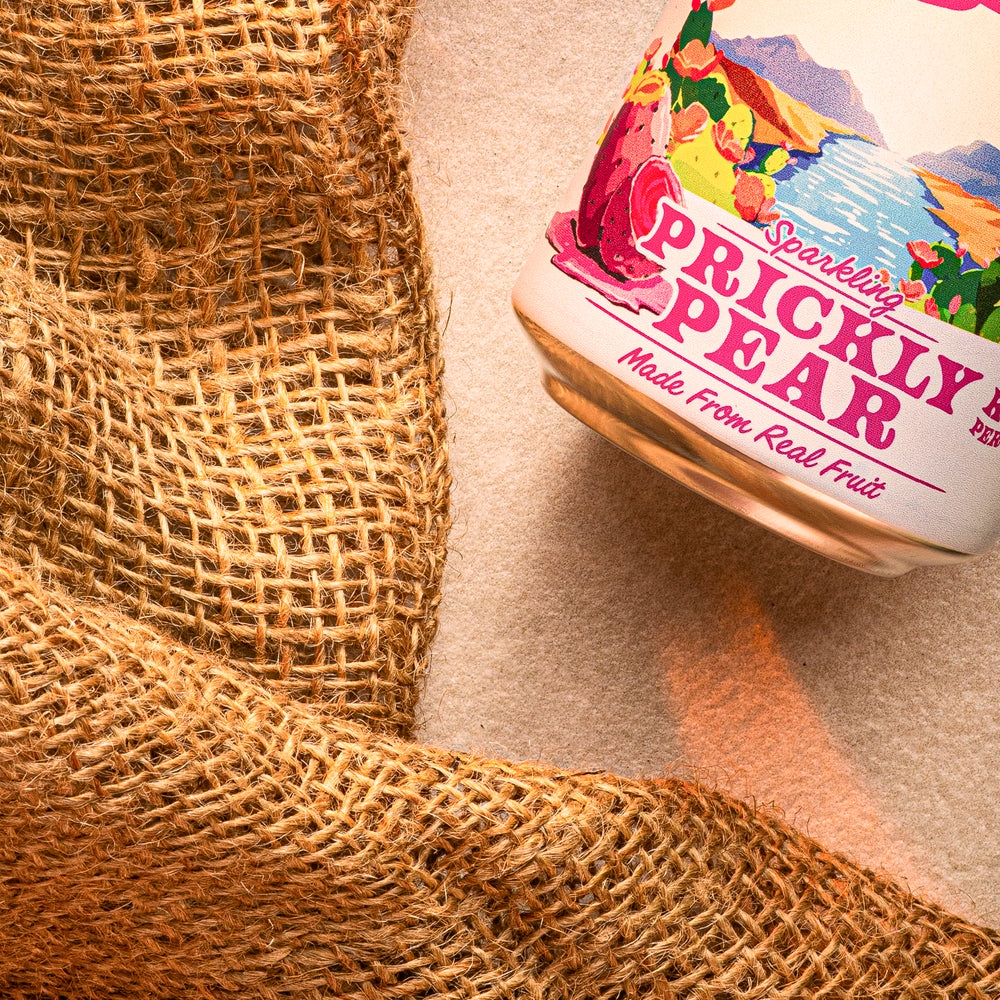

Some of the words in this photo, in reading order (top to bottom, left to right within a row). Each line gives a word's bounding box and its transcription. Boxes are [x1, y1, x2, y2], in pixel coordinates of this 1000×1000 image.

[639, 204, 984, 417] PRICKLY
[765, 219, 905, 319] Sparkling
[617, 346, 687, 397] Made
[687, 390, 753, 436] From
[754, 424, 820, 469] Real
[820, 458, 886, 501] Fruit
[653, 278, 903, 450] PEAR
